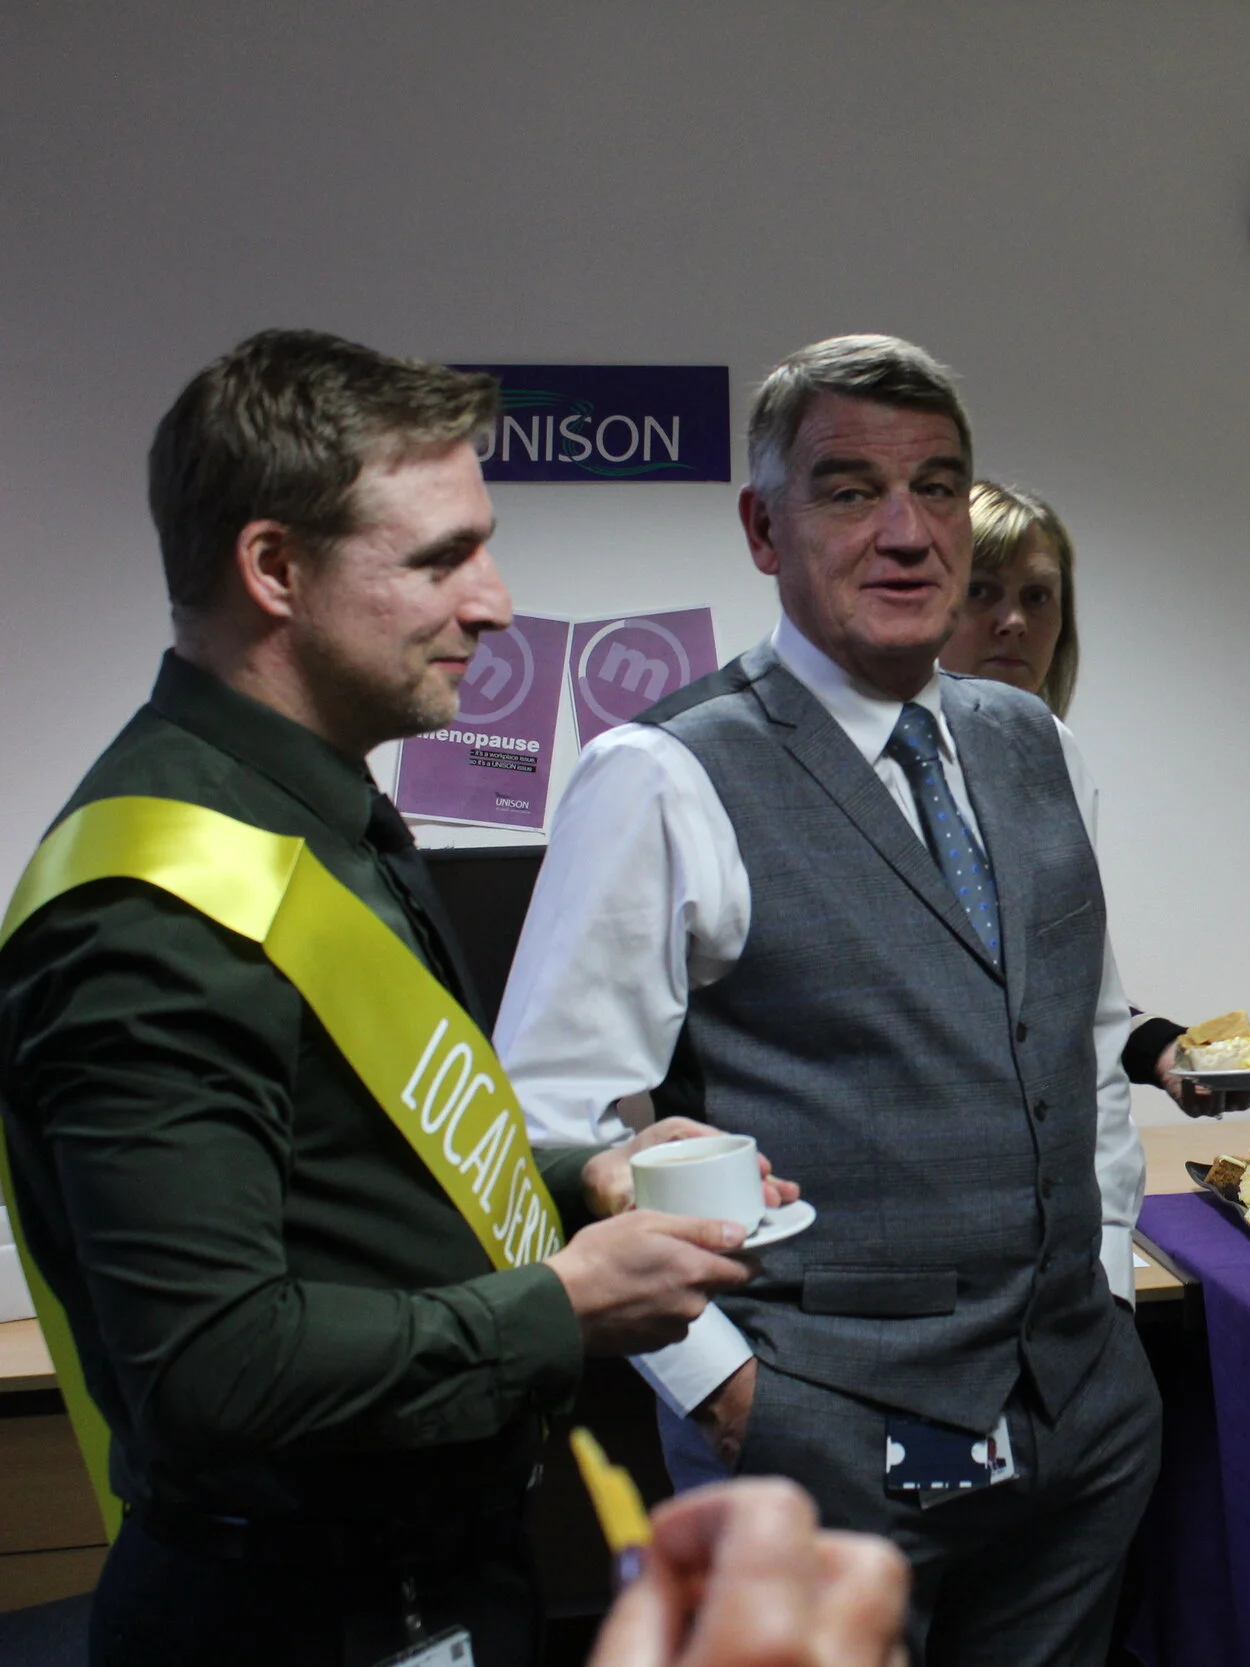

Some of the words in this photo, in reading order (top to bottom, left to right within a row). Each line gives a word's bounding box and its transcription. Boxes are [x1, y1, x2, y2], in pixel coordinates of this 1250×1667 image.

[491, 761, 517, 770] UNISON
[495, 798, 530, 809] UNISON
[401, 1017, 516, 1214] LOCAL
[492, 1156, 560, 1269] SERV
